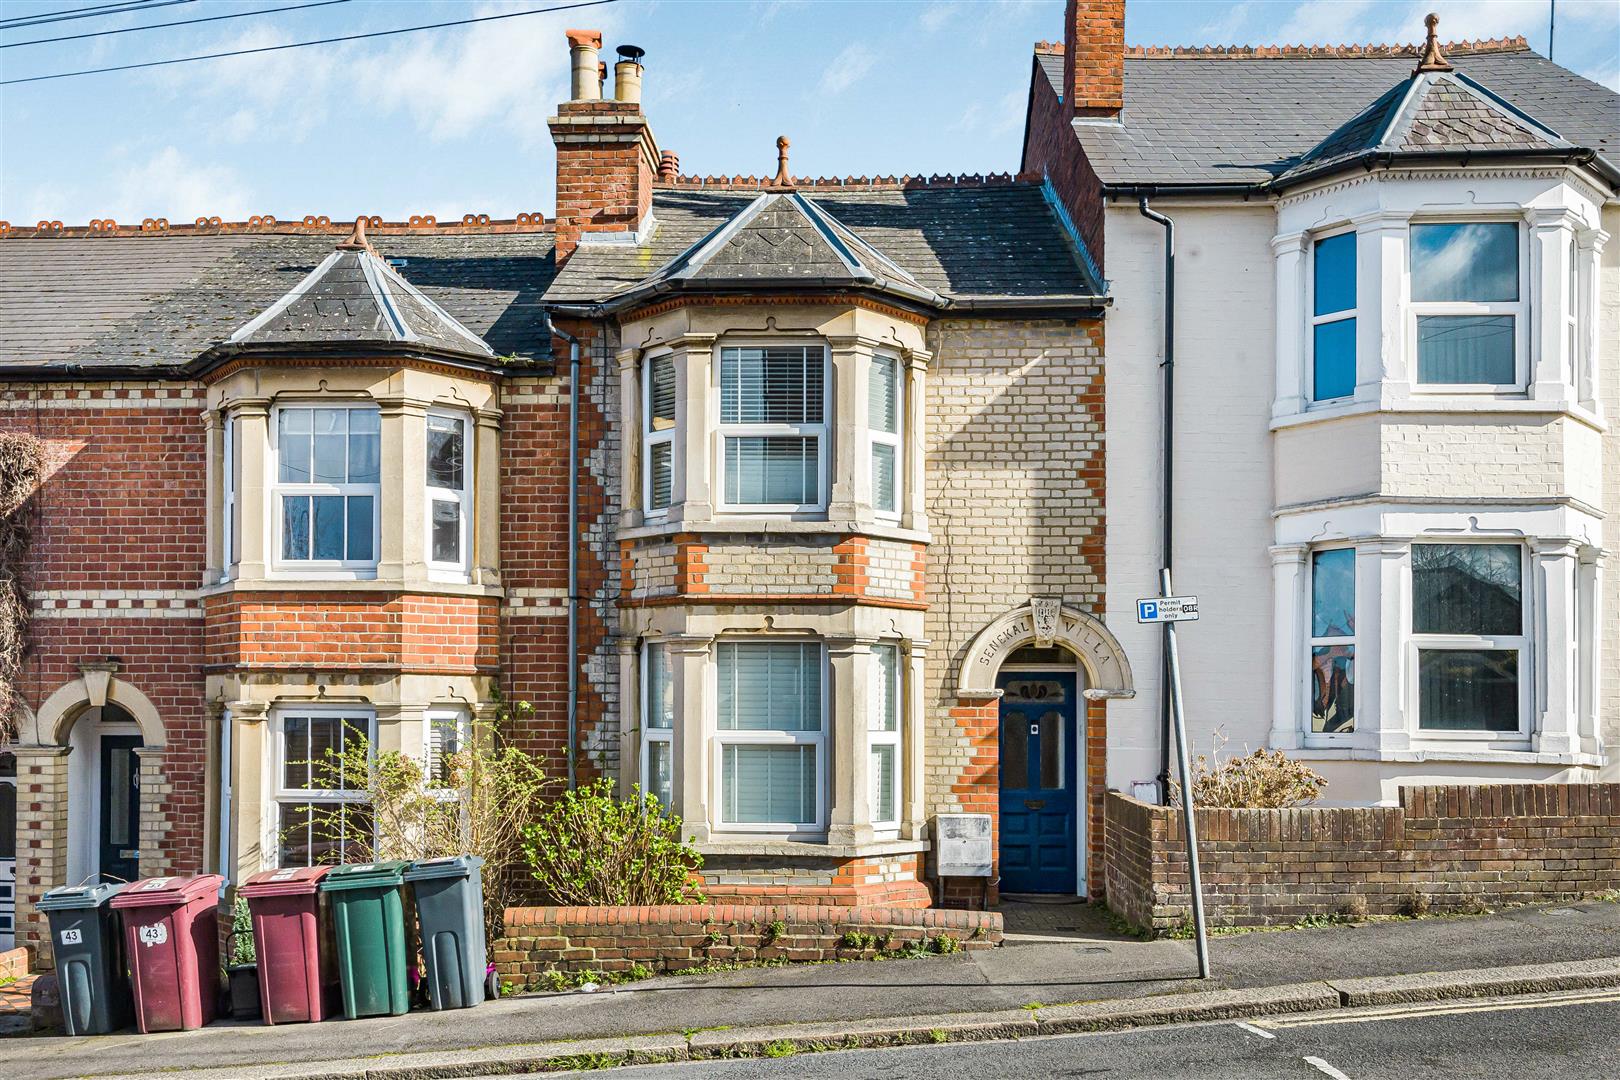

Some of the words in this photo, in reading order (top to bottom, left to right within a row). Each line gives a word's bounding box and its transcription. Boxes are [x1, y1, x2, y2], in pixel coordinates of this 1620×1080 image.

[1144, 604, 1155, 618] P
[979, 622, 1030, 666] SENEKAL
[1065, 622, 1111, 665] VILLA
[65, 931, 78, 940] 43
[145, 929, 159, 939] 43
